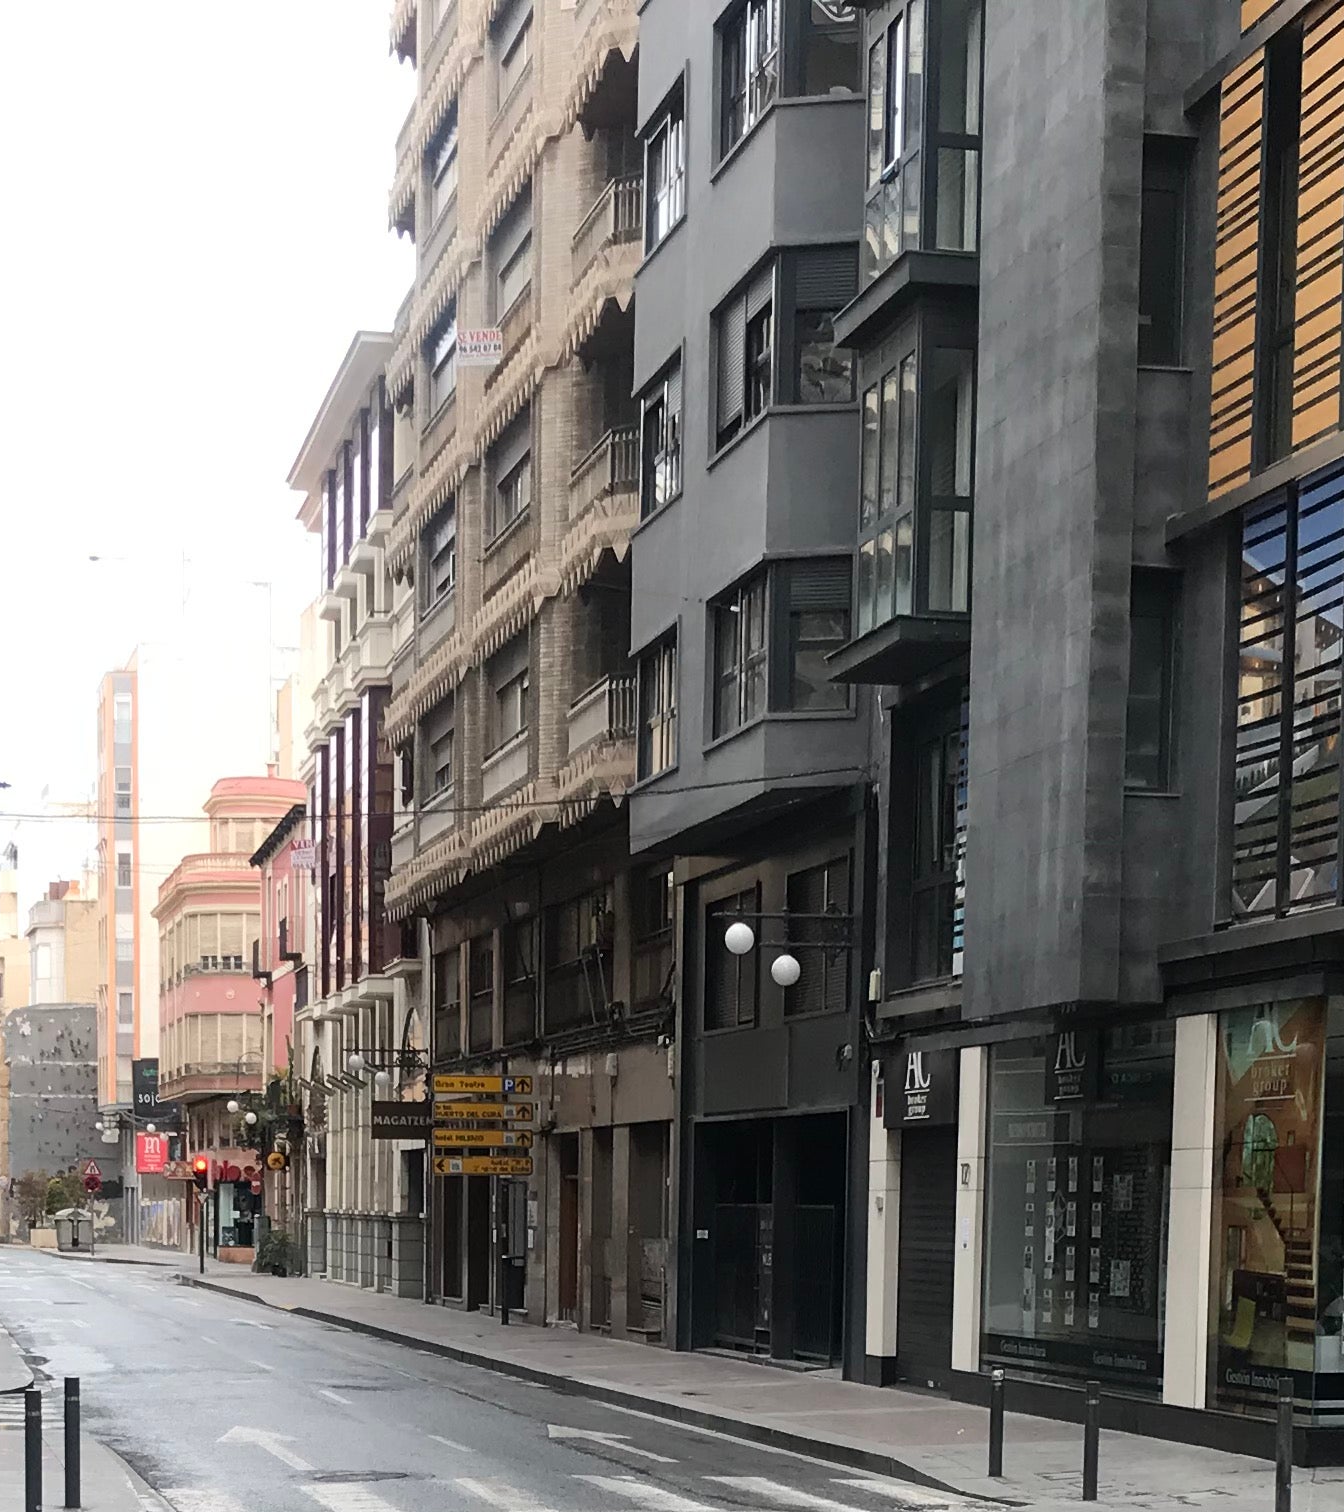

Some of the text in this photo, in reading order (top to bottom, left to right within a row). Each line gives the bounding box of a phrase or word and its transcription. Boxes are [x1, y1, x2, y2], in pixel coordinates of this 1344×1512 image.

[458, 331, 500, 344] SE VENDE
[1251, 1061, 1290, 1078] broker
[1253, 1079, 1287, 1097] group
